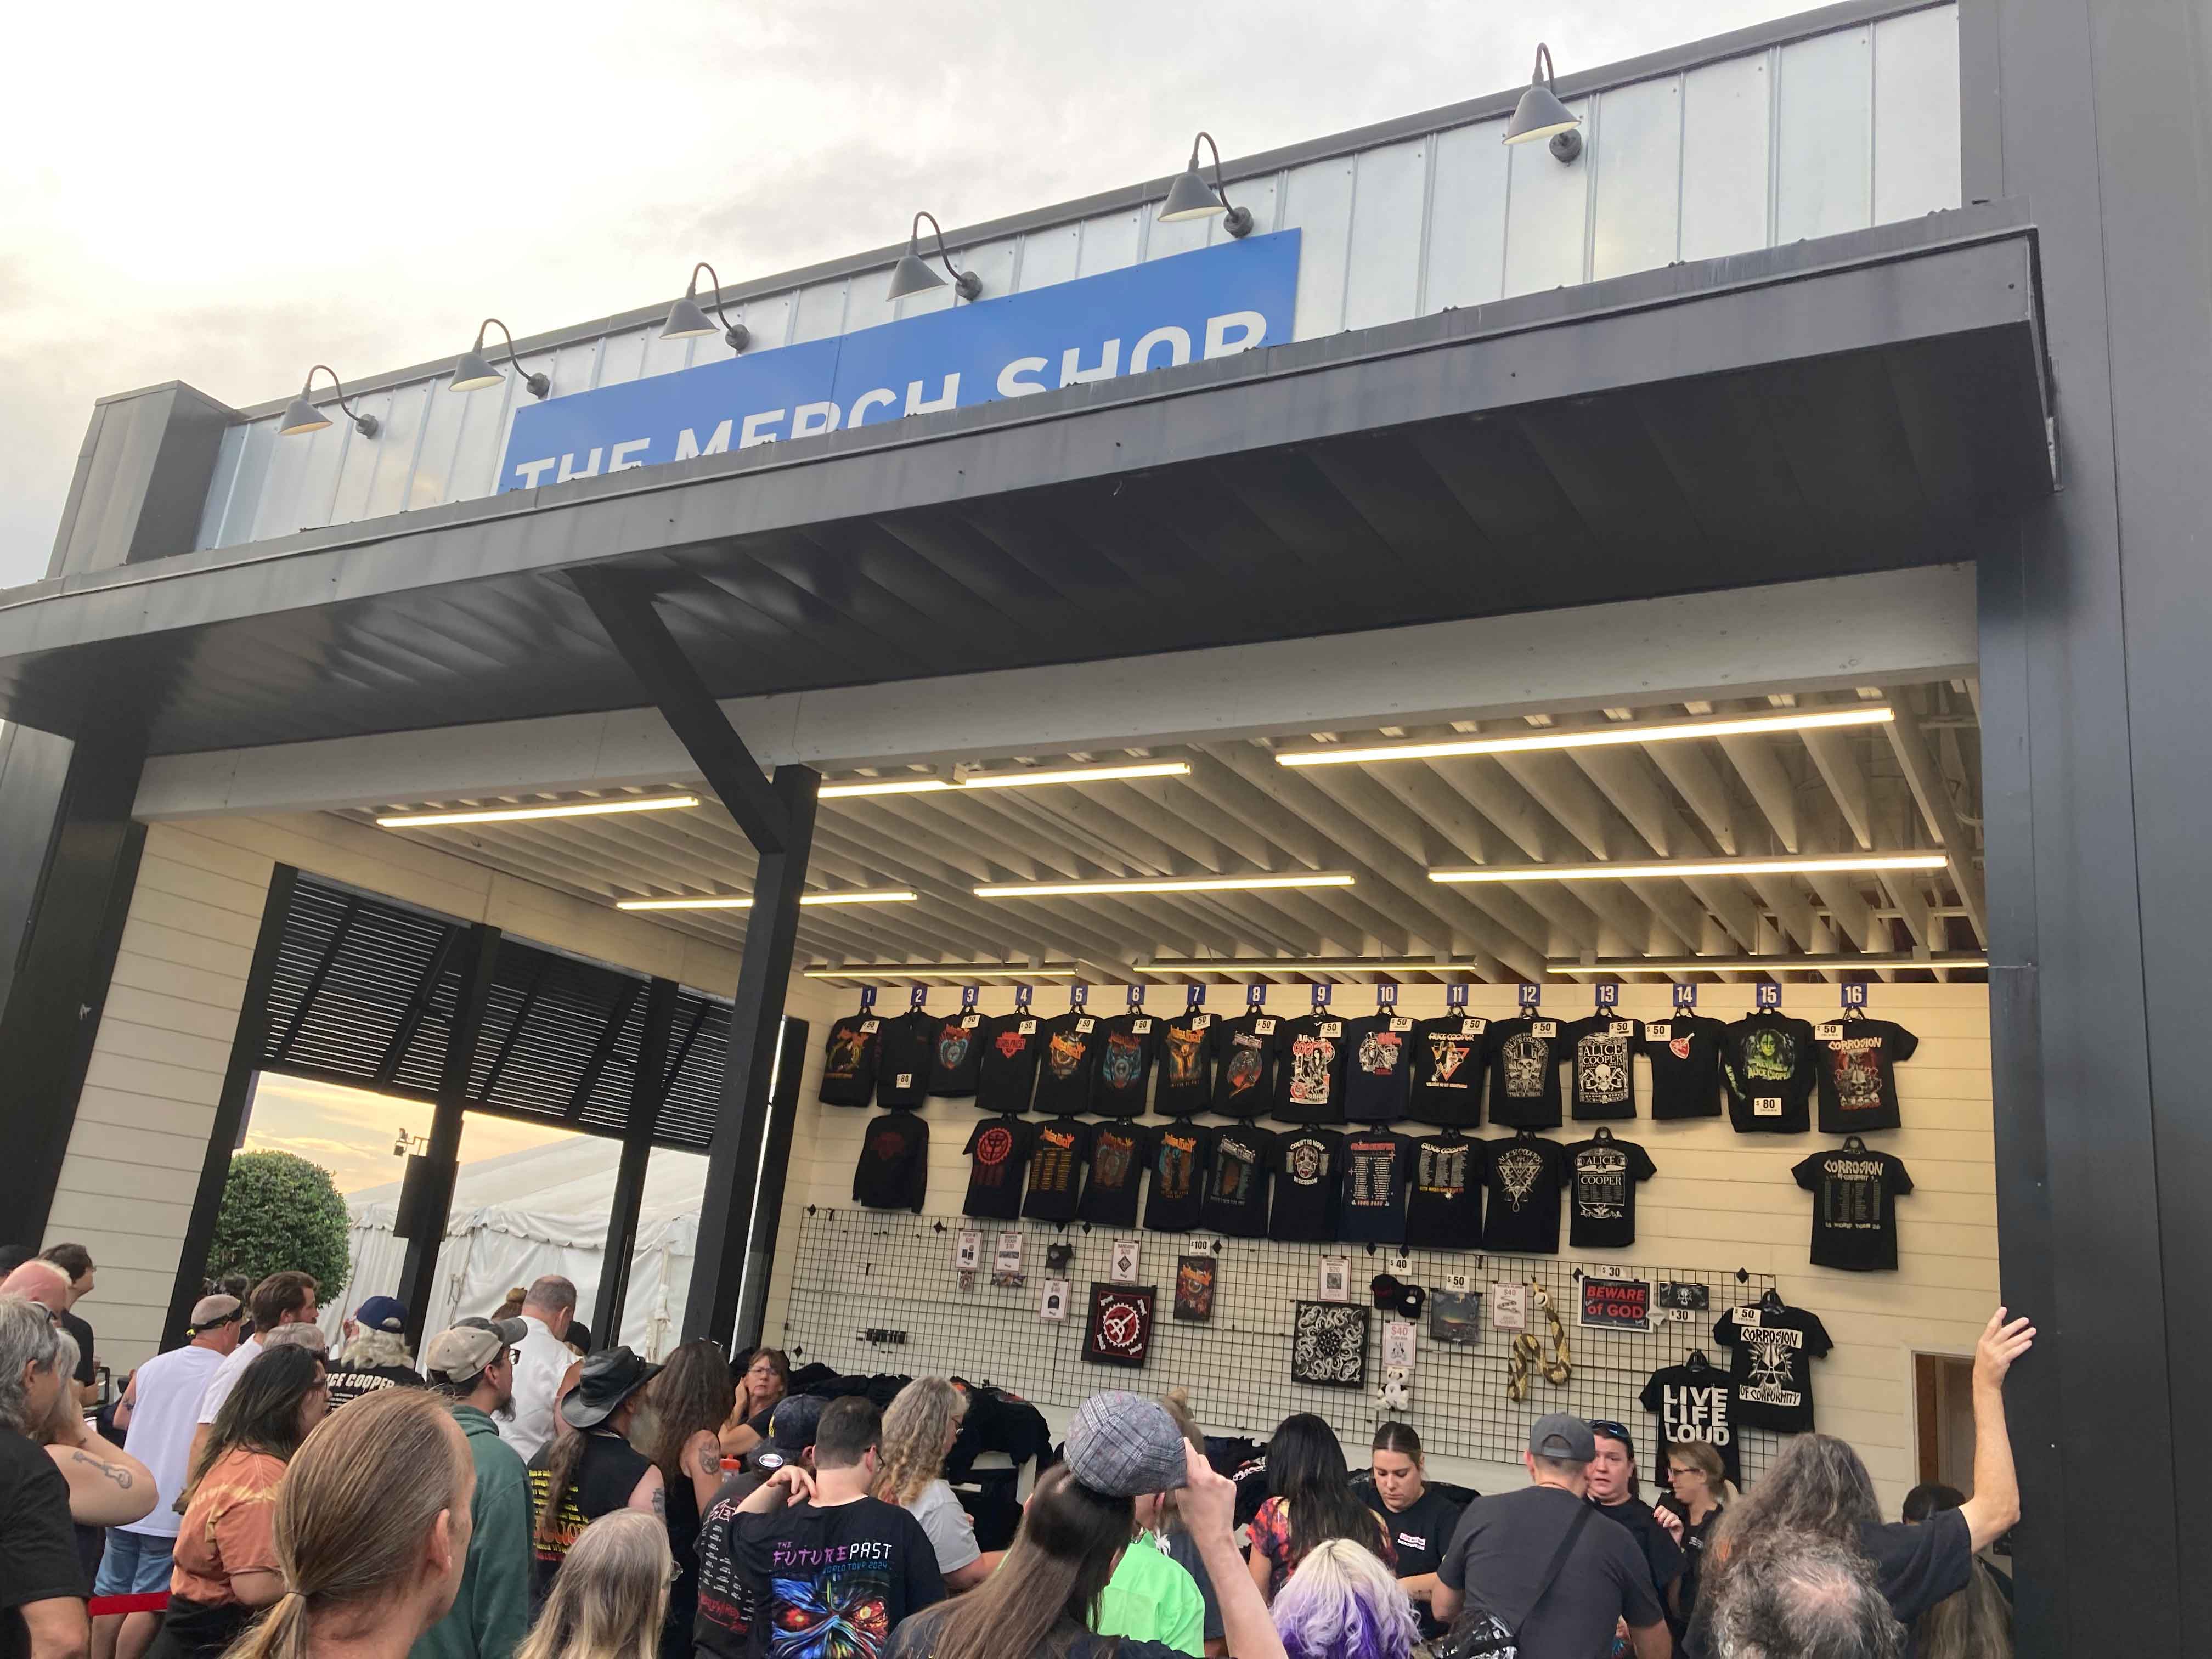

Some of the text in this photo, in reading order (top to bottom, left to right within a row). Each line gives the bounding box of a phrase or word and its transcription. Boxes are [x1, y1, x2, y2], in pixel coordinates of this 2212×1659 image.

[866, 990, 872, 1003] 1
[915, 989, 923, 1002] 2
[967, 989, 974, 1002] 3
[1020, 988, 1028, 1001] 4
[1075, 988, 1083, 1001] 5
[1132, 987, 1140, 1001] 6
[1193, 987, 1200, 1001] 7
[1252, 986, 1260, 1001] 8
[1317, 986, 1325, 1002] 9
[1380, 986, 1394, 1002] 10
[1453, 986, 1463, 1002] 11
[1522, 986, 1536, 1002] 12
[1600, 986, 1615, 1002] 13
[1677, 986, 1692, 1003] 14
[1760, 986, 1777, 1003] 15
[1845, 986, 1862, 1004] 16
[1583, 1044, 1622, 1056] ALICE
[1829, 1037, 1882, 1051] CORROSION
[1583, 1054, 1623, 1065] COOPER
[1587, 1156, 1616, 1165] ALICE
[1824, 1159, 1883, 1176] CORROSION
[1581, 1176, 1622, 1186] COOPER
[1586, 1285, 1645, 1301] BEWARE
[1587, 1303, 1645, 1319] of GOD
[1391, 1326, 1408, 1335] $40
[1742, 1328, 1798, 1346] CORROSION
[1663, 1384, 1728, 1407] LIVE
[1740, 1386, 1800, 1406] OF CONFORMITY
[1663, 1403, 1728, 1427] LIFE
[1664, 1422, 1730, 1446] LOUD
[777, 1541, 793, 1549] THE
[772, 1542, 893, 1567] FUTURE PAST
[868, 1561, 888, 1570] 2024
